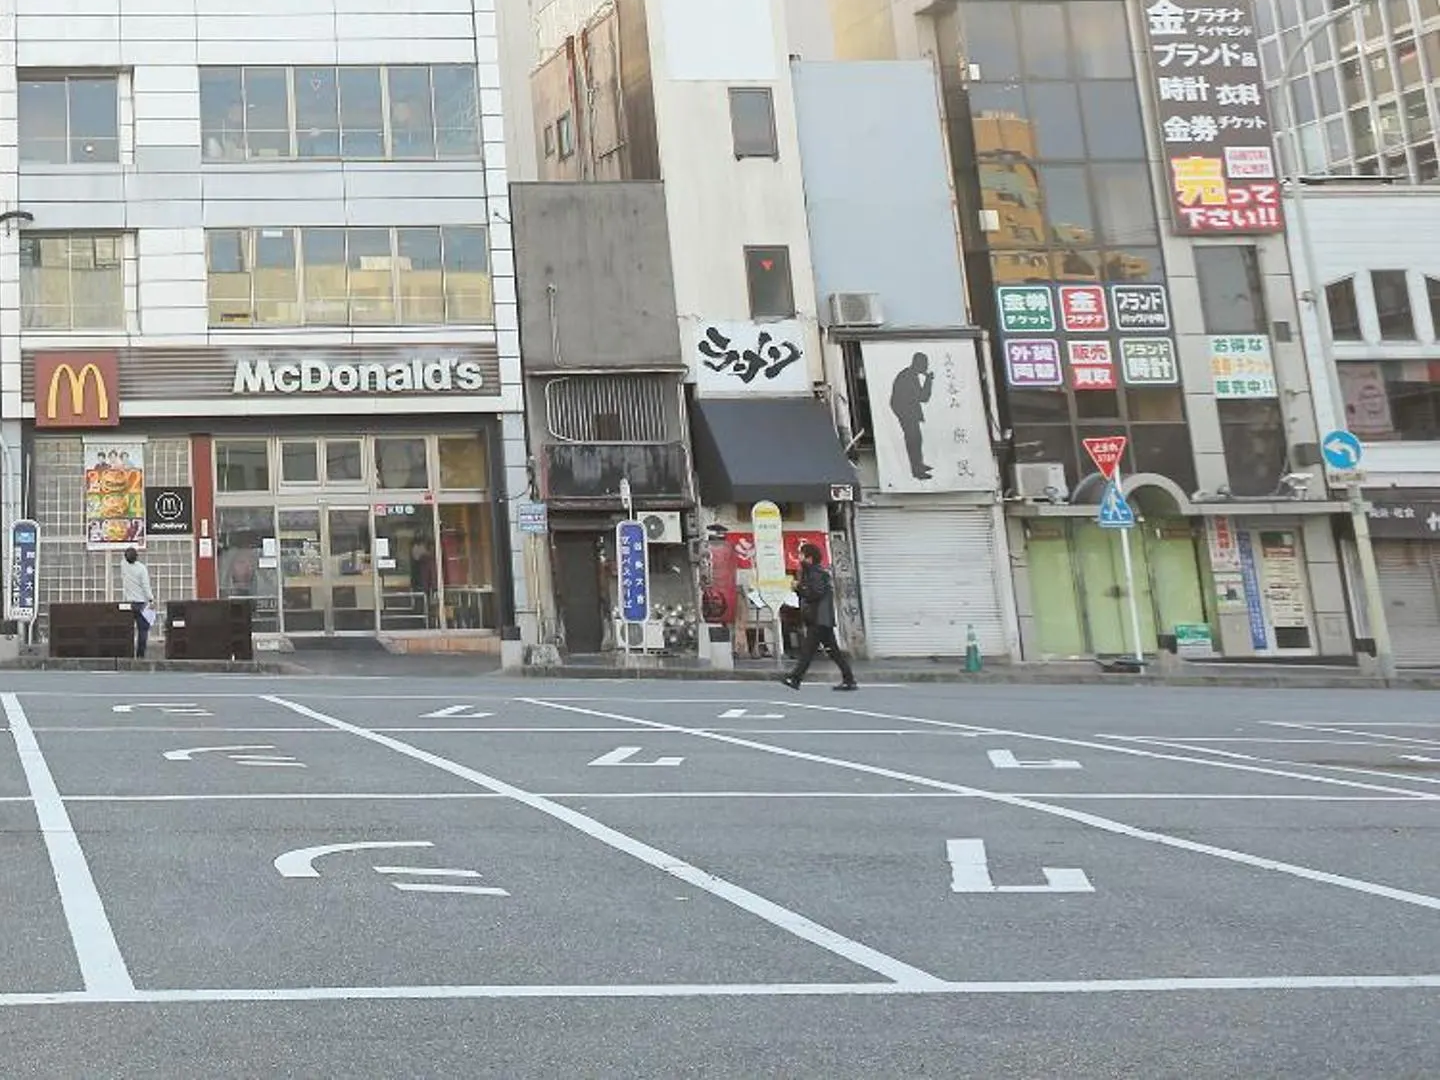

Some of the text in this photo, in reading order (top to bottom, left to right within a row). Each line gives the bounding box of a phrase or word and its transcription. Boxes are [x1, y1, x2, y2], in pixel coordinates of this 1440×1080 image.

[1153, 42, 1257, 67] ブランド品
[1158, 75, 1209, 101] 時計
[1164, 115, 1218, 142] 金券
[1068, 291, 1097, 312] 金
[1117, 292, 1162, 310] ブランド
[1006, 315, 1050, 325] チケット
[1125, 343, 1169, 355] ブランド
[233, 358, 483, 392] McDonald's
[1128, 357, 1171, 378] 時計
